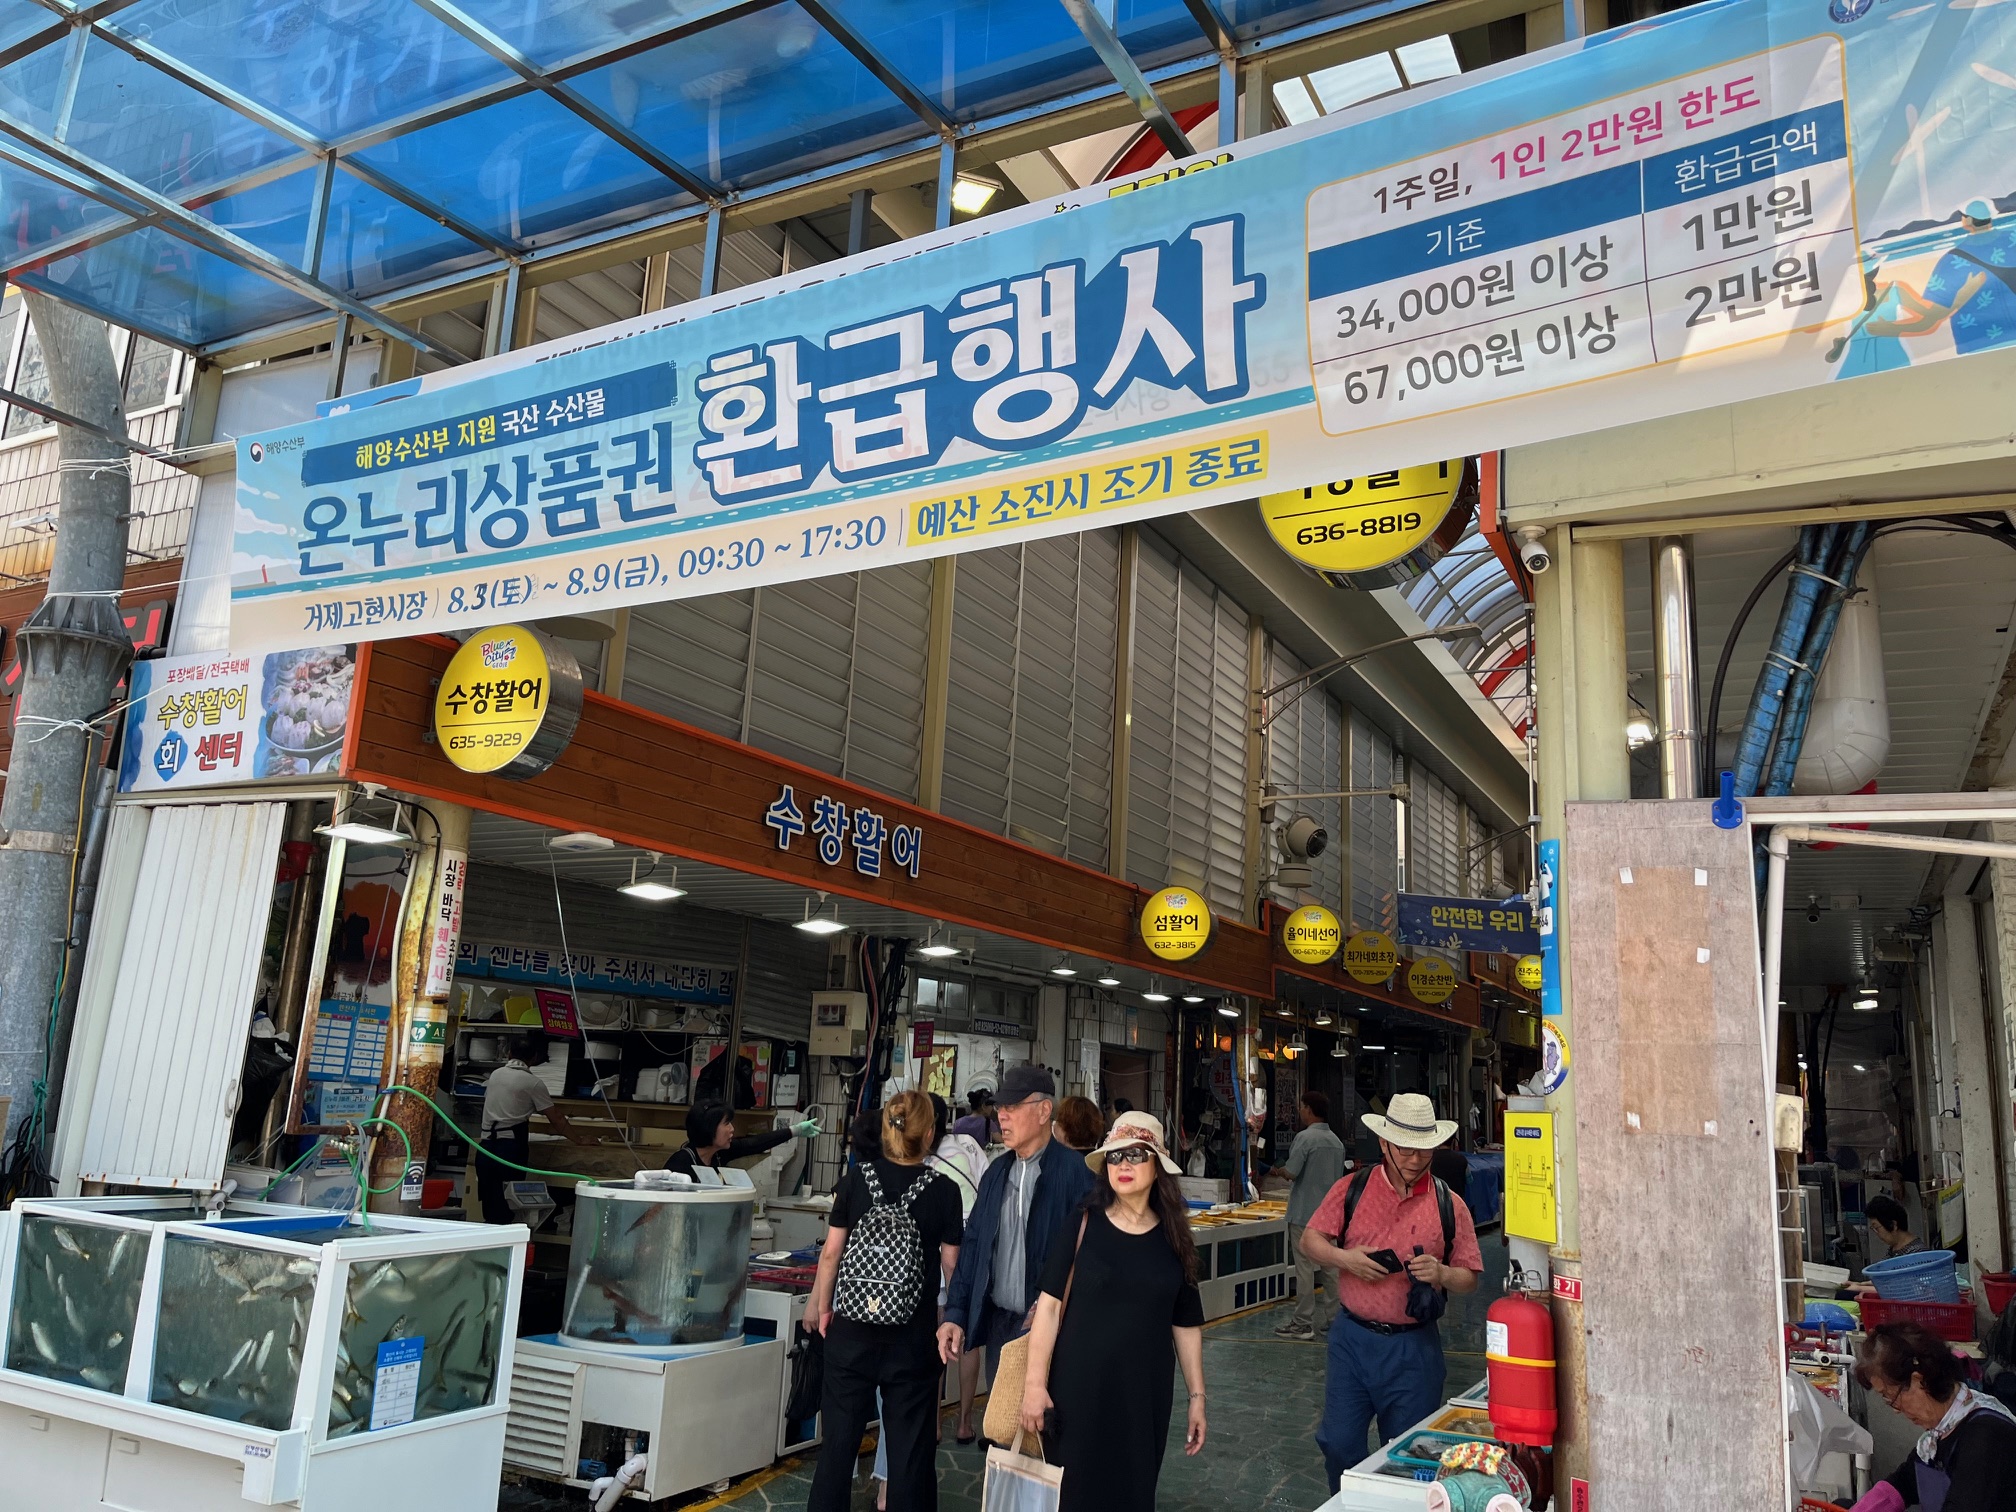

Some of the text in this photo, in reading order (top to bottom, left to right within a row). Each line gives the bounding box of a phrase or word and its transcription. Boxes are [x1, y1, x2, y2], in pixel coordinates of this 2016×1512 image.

[1372, 75, 1760, 214] 1주일, 1인 2만원 한도
[1673, 121, 1818, 194] 환급금액
[1682, 179, 1814, 253] 1만원
[1426, 218, 1486, 256] 기준
[1335, 235, 1614, 339] 34,000원 이상
[1684, 251, 1822, 329] 2만원
[695, 214, 1262, 500] 환급행사
[1344, 305, 1619, 407] 67,000원 이상
[265, 436, 306, 455] 해양수산부
[356, 388, 606, 470] 해양수산부 지원 국산 수산물
[297, 421, 678, 577] 온누리상품권
[916, 495, 981, 538] 예산
[988, 474, 1090, 527] 소진시
[1100, 454, 1173, 505] 조기
[1185, 437, 1264, 488] 종료
[677, 538, 765, 579] 09:30
[801, 516, 887, 559] 17:30
[1296, 512, 1422, 546] 636-8819
[303, 592, 428, 632] 거제고현시장
[481, 640, 505, 656] Blue
[484, 649, 505, 666] City
[157, 684, 248, 730] 수창활어
[444, 677, 542, 716] 수창활어
[158, 731, 243, 773] 회 센터
[449, 731, 522, 750] 635-9229
[765, 784, 923, 879] 수창활어
[445, 859, 457, 888] 시장
[440, 893, 453, 922] 바닥
[1154, 914, 1198, 931] 섬활어
[1430, 906, 1484, 930] 안전한
[1489, 910, 1524, 932] 우리
[1154, 941, 1196, 949] 632-3815
[1287, 927, 1338, 941] 율이네선어
[432, 965, 445, 980] 시
[604, 957, 655, 987] 주셔서
[1347, 951, 1394, 963] 최가네회초장
[1411, 974, 1453, 986] 이경순찬반
